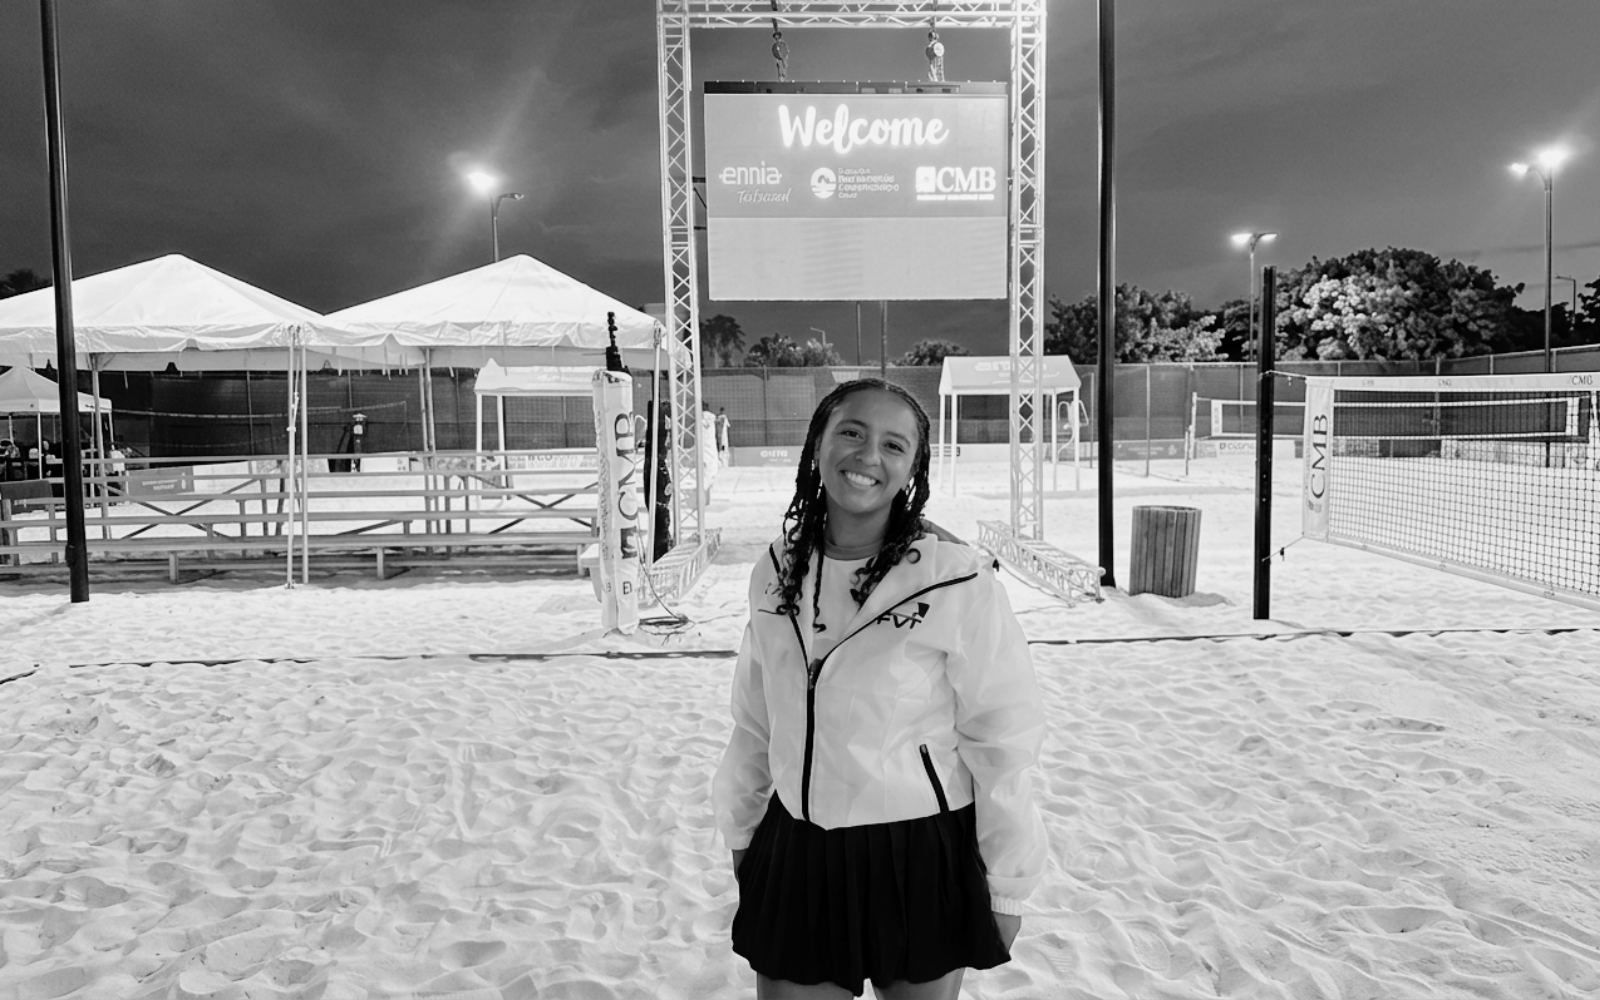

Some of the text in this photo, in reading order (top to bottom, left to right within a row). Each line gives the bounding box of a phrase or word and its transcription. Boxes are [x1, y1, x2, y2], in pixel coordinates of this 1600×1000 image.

[778, 103, 949, 154] Welcome
[719, 160, 782, 185] ennia
[936, 166, 997, 193] CMB
[1310, 414, 1328, 499] CMB
